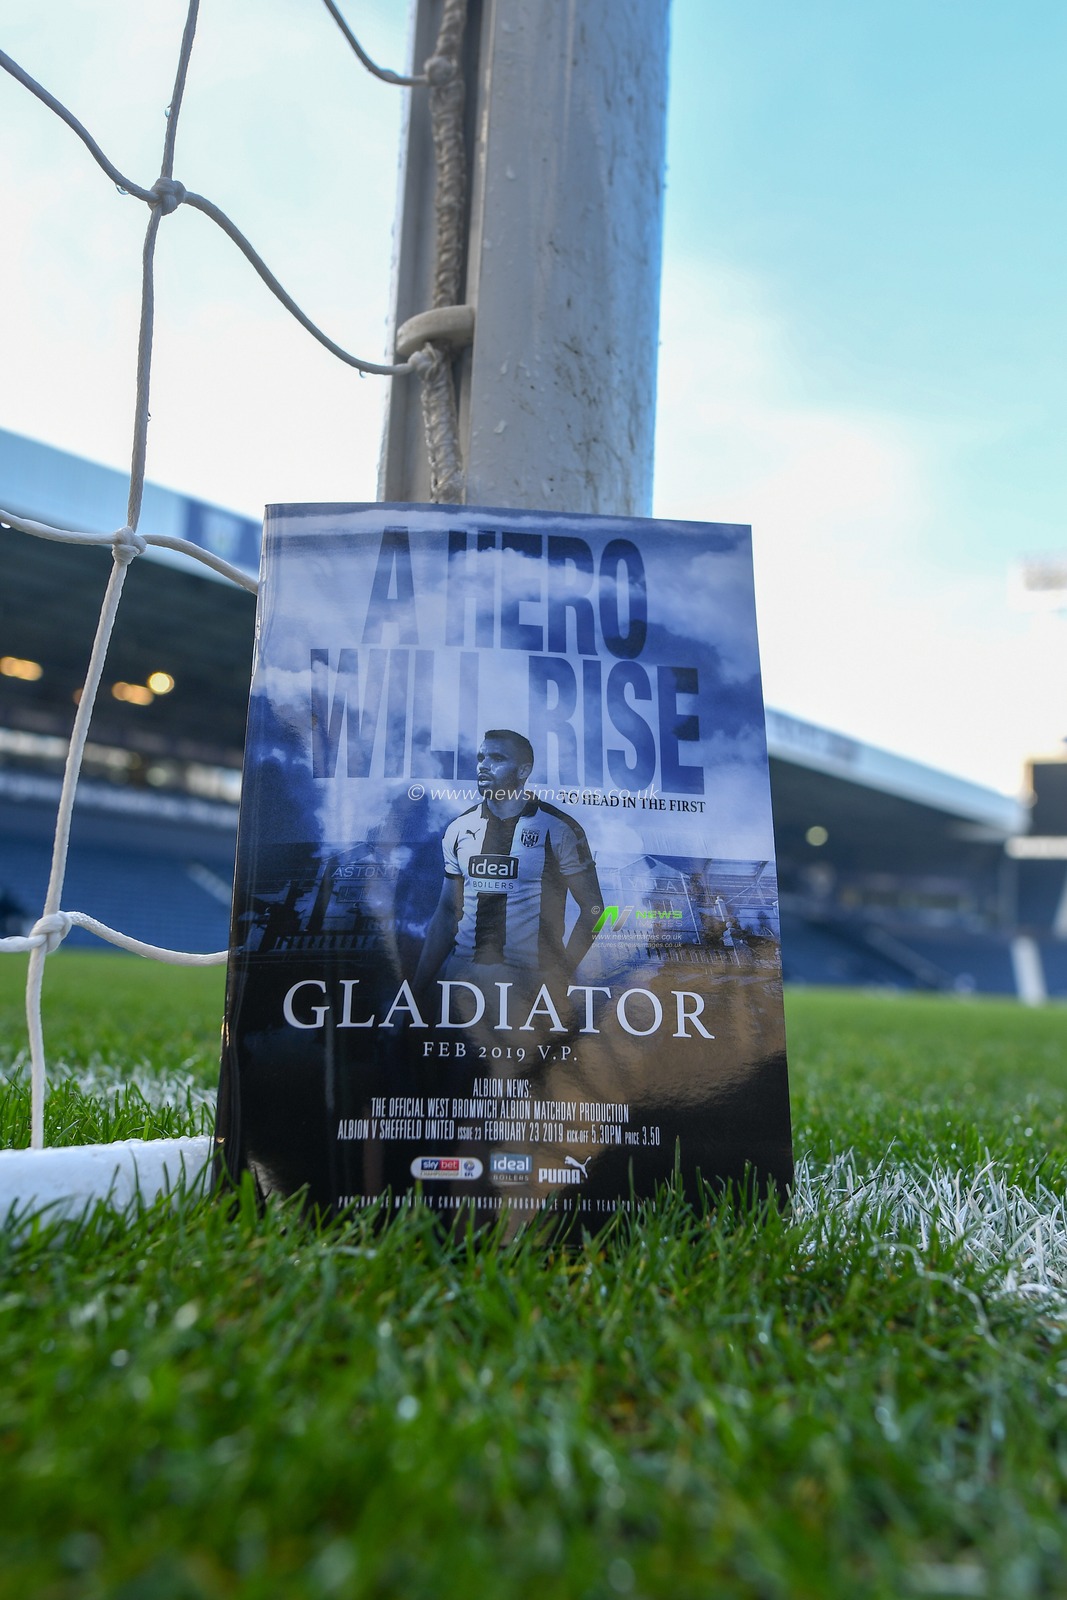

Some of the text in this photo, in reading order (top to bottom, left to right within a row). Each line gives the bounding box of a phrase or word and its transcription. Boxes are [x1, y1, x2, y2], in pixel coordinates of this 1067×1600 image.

[361, 526, 648, 660] A HERO
[310, 648, 705, 795] WILL RISE
[559, 791, 706, 813] TO HEAD IN THE FIRST
[330, 866, 387, 878] ASTON
[471, 858, 514, 876] ideal
[472, 881, 514, 889] BOILERS
[283, 979, 716, 1040] GLADIATOR
[422, 1041, 578, 1062] FEB 2019 V.P.
[473, 1078, 532, 1098] ALBION NEWS:
[371, 1097, 630, 1123] THE OFFICIAL WEST BROMWICH ALBION MATCHDAY PRODUCTION
[337, 1119, 661, 1146] ALBION V SHEFFIELD UNITED ISSUE 23 FEBRUARY 23 2019 KICK-OFF 5.30PM PRICE 3.50
[422, 1159, 458, 1170] sky bet
[493, 1156, 529, 1171] ideal
[493, 1174, 529, 1182] BOILERS
[539, 1168, 580, 1184] PUMA
[596, 1199, 616, 1212] YEAR
